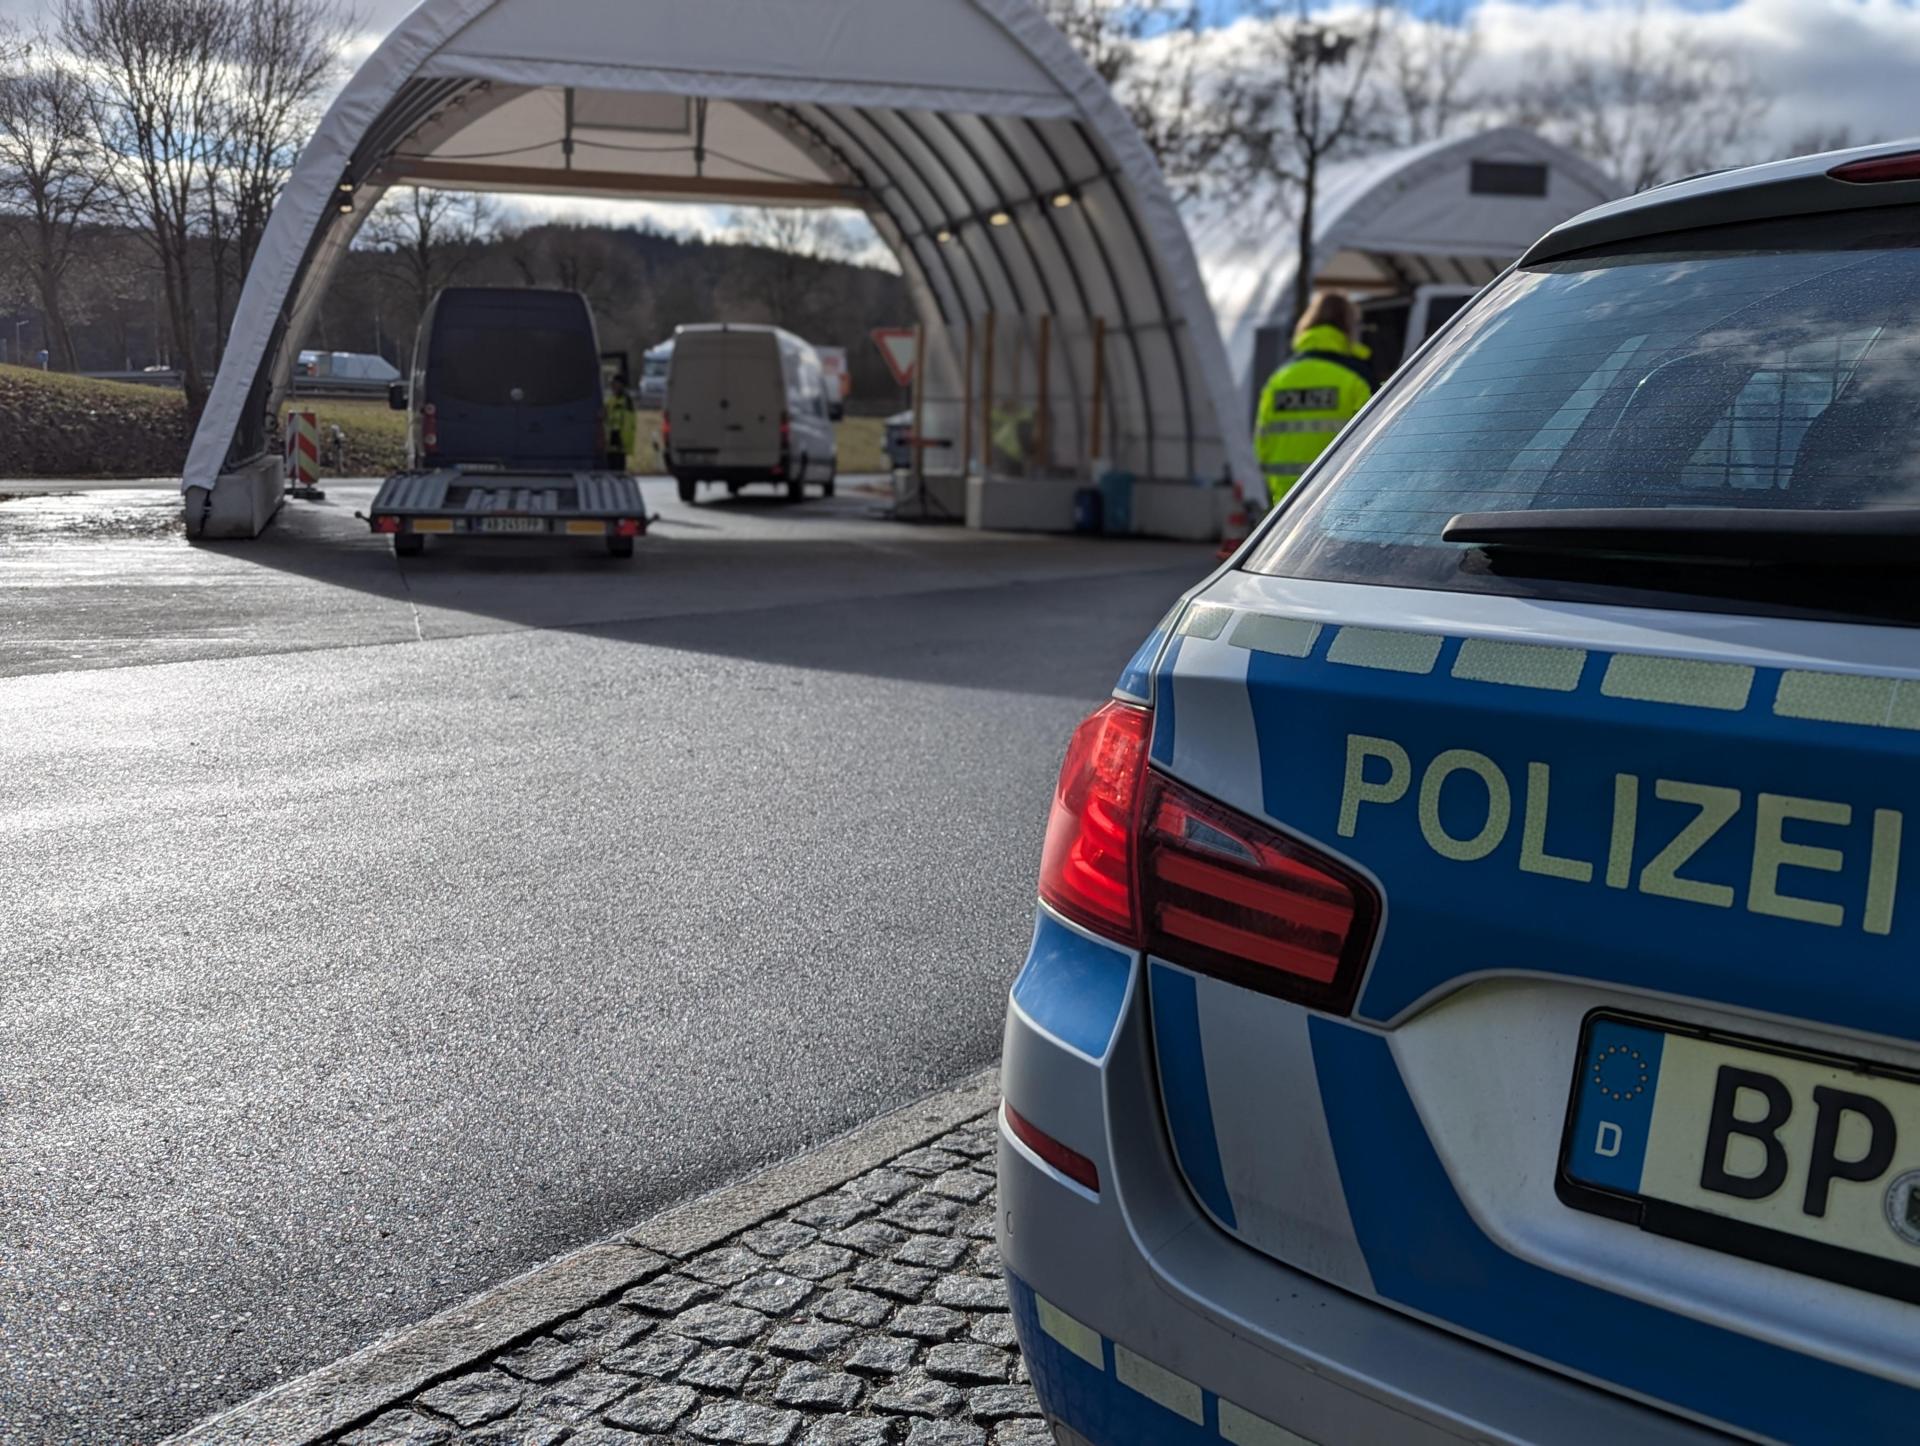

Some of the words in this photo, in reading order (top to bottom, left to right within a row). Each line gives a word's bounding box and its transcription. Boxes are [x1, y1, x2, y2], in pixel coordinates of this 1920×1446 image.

[1337, 734, 1903, 935] POLIZEI
[1594, 1121, 1622, 1157] D
[1701, 1065, 1897, 1218] BP
